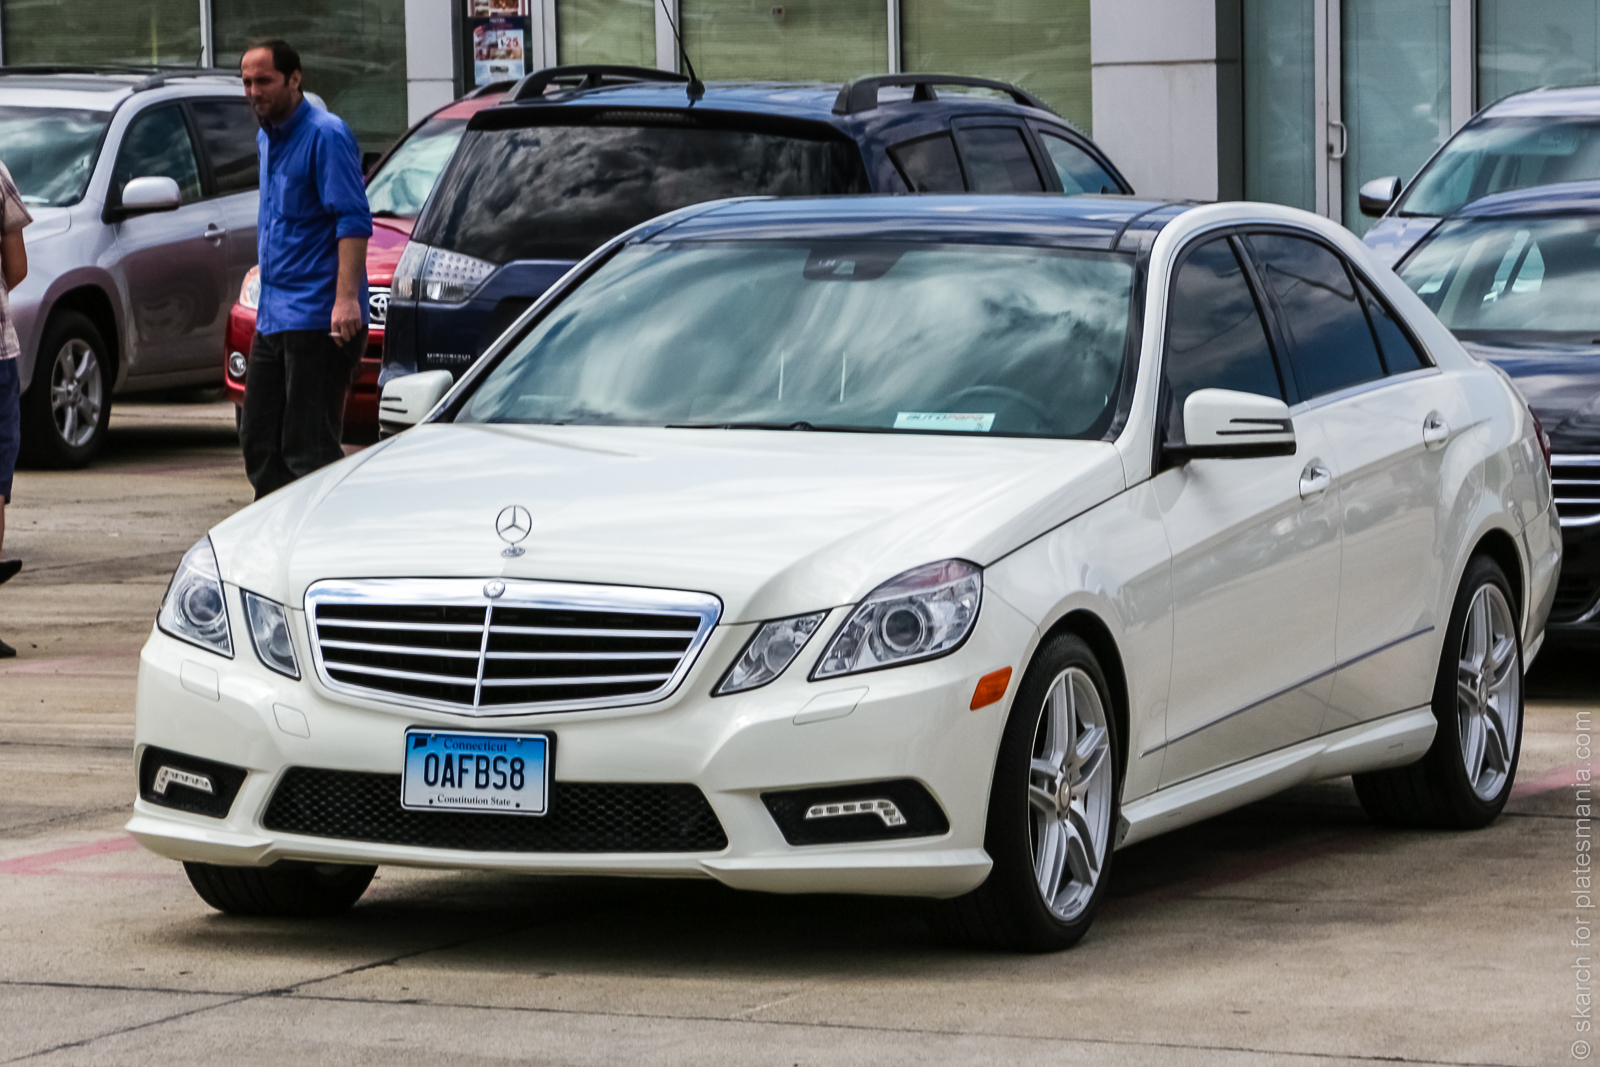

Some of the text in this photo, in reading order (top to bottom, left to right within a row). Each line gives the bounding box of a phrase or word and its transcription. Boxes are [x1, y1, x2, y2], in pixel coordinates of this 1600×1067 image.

[443, 738, 508, 752] Connecticut
[437, 794, 511, 807] Constitution State
